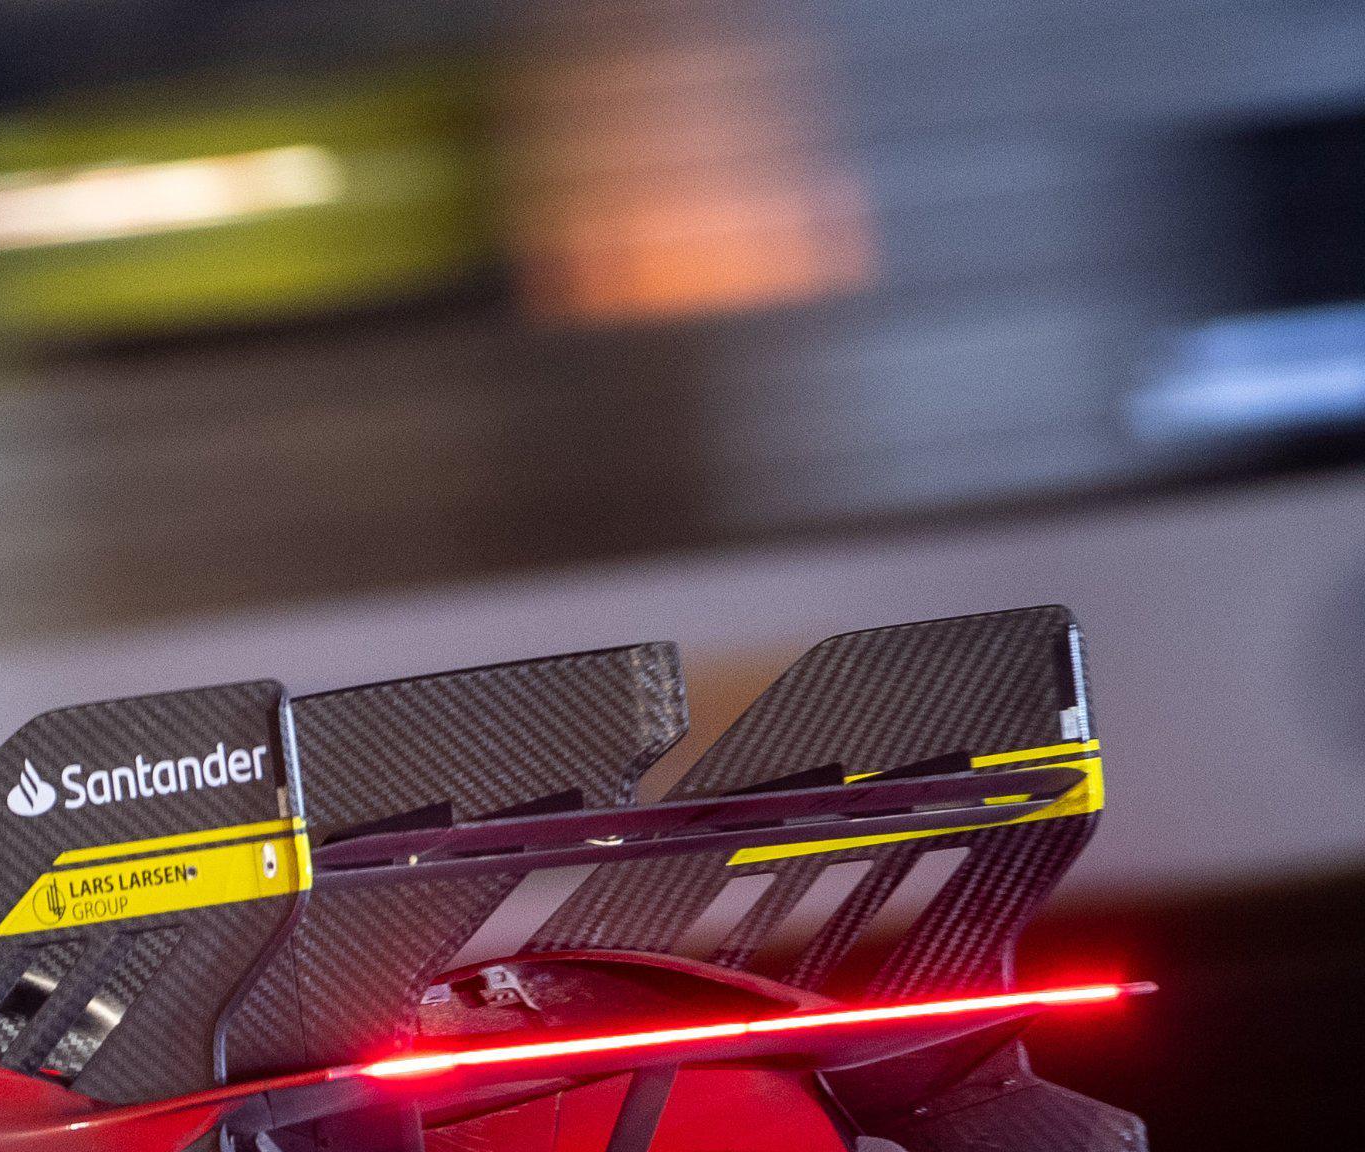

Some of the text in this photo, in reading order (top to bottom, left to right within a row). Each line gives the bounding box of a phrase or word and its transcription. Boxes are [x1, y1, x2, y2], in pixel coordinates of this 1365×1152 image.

[60, 741, 268, 809] Santander
[69, 864, 188, 898] LARS LARSEN
[72, 895, 128, 921] GROUP
